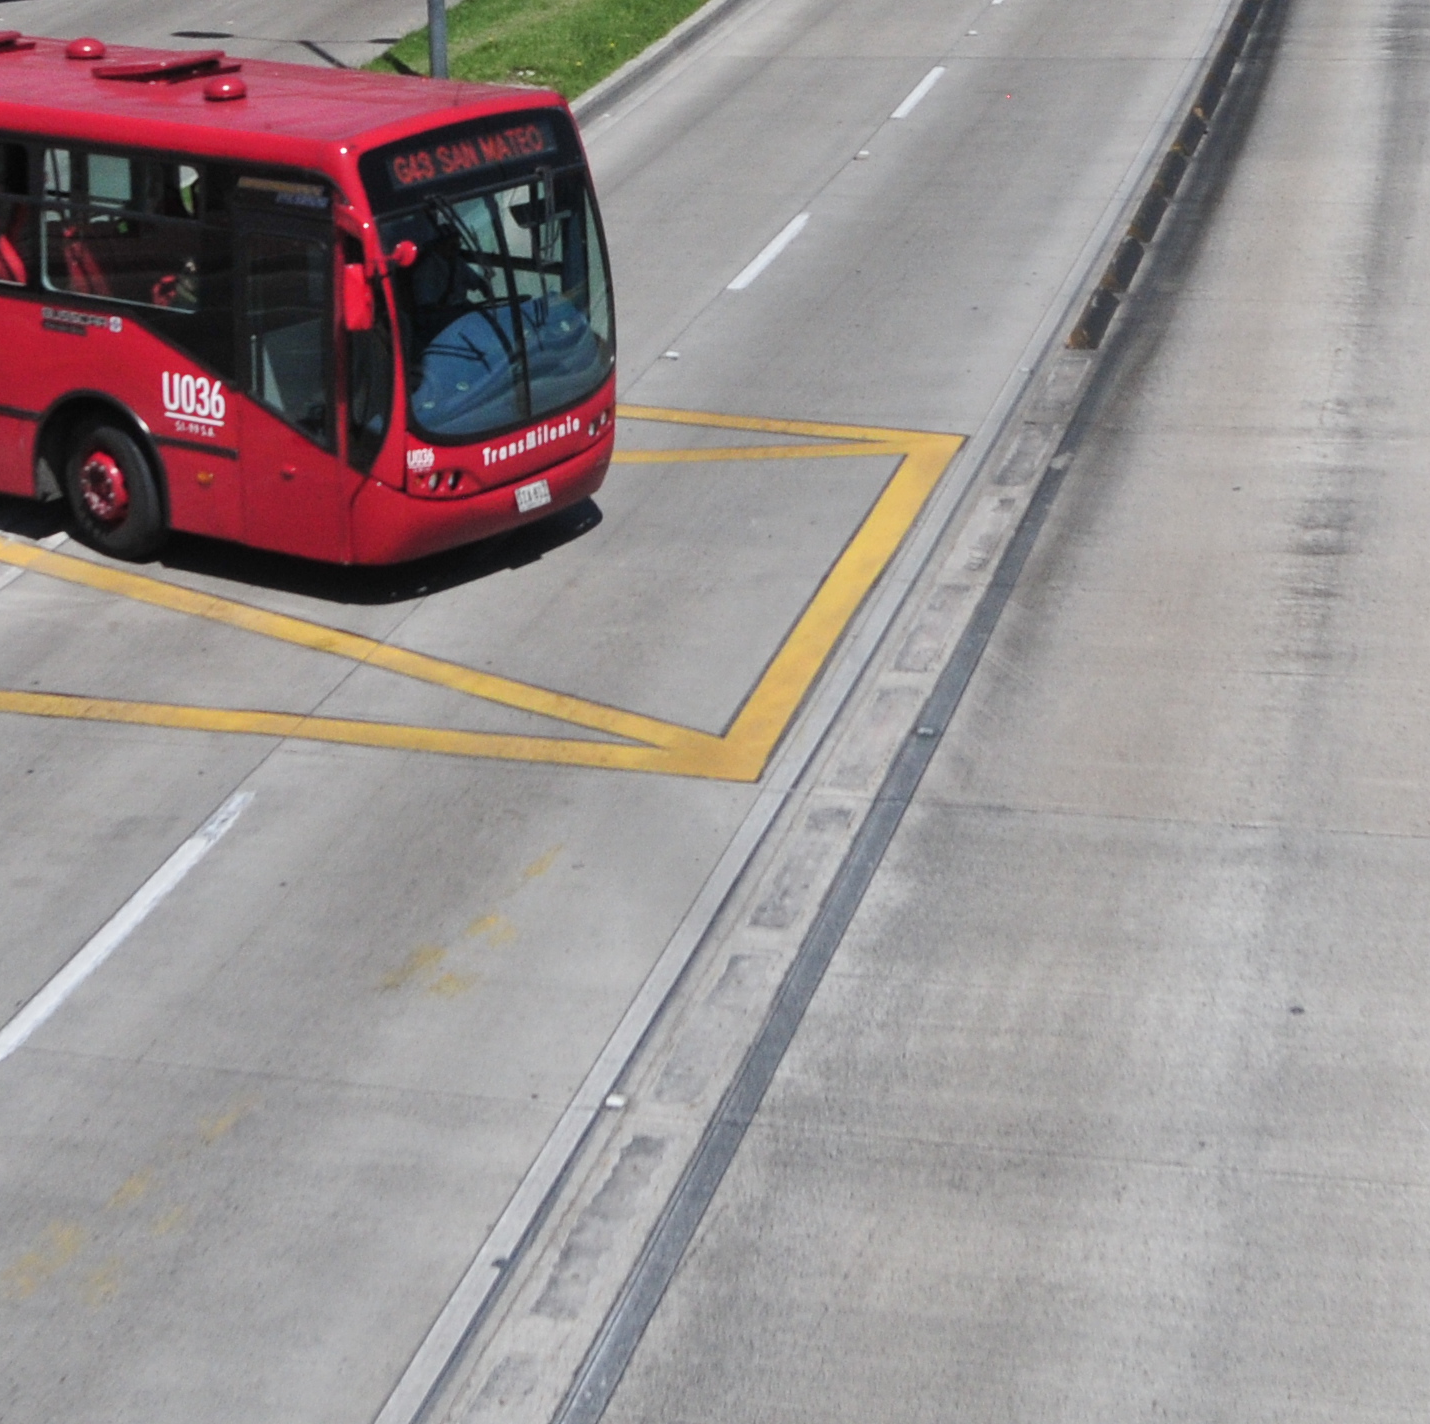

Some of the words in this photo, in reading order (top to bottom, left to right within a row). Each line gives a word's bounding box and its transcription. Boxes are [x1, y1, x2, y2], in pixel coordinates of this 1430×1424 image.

[436, 140, 480, 174] SAN
[478, 125, 545, 163] MATEO
[162, 370, 226, 420] U036
[482, 415, 581, 467] TransMilenio
